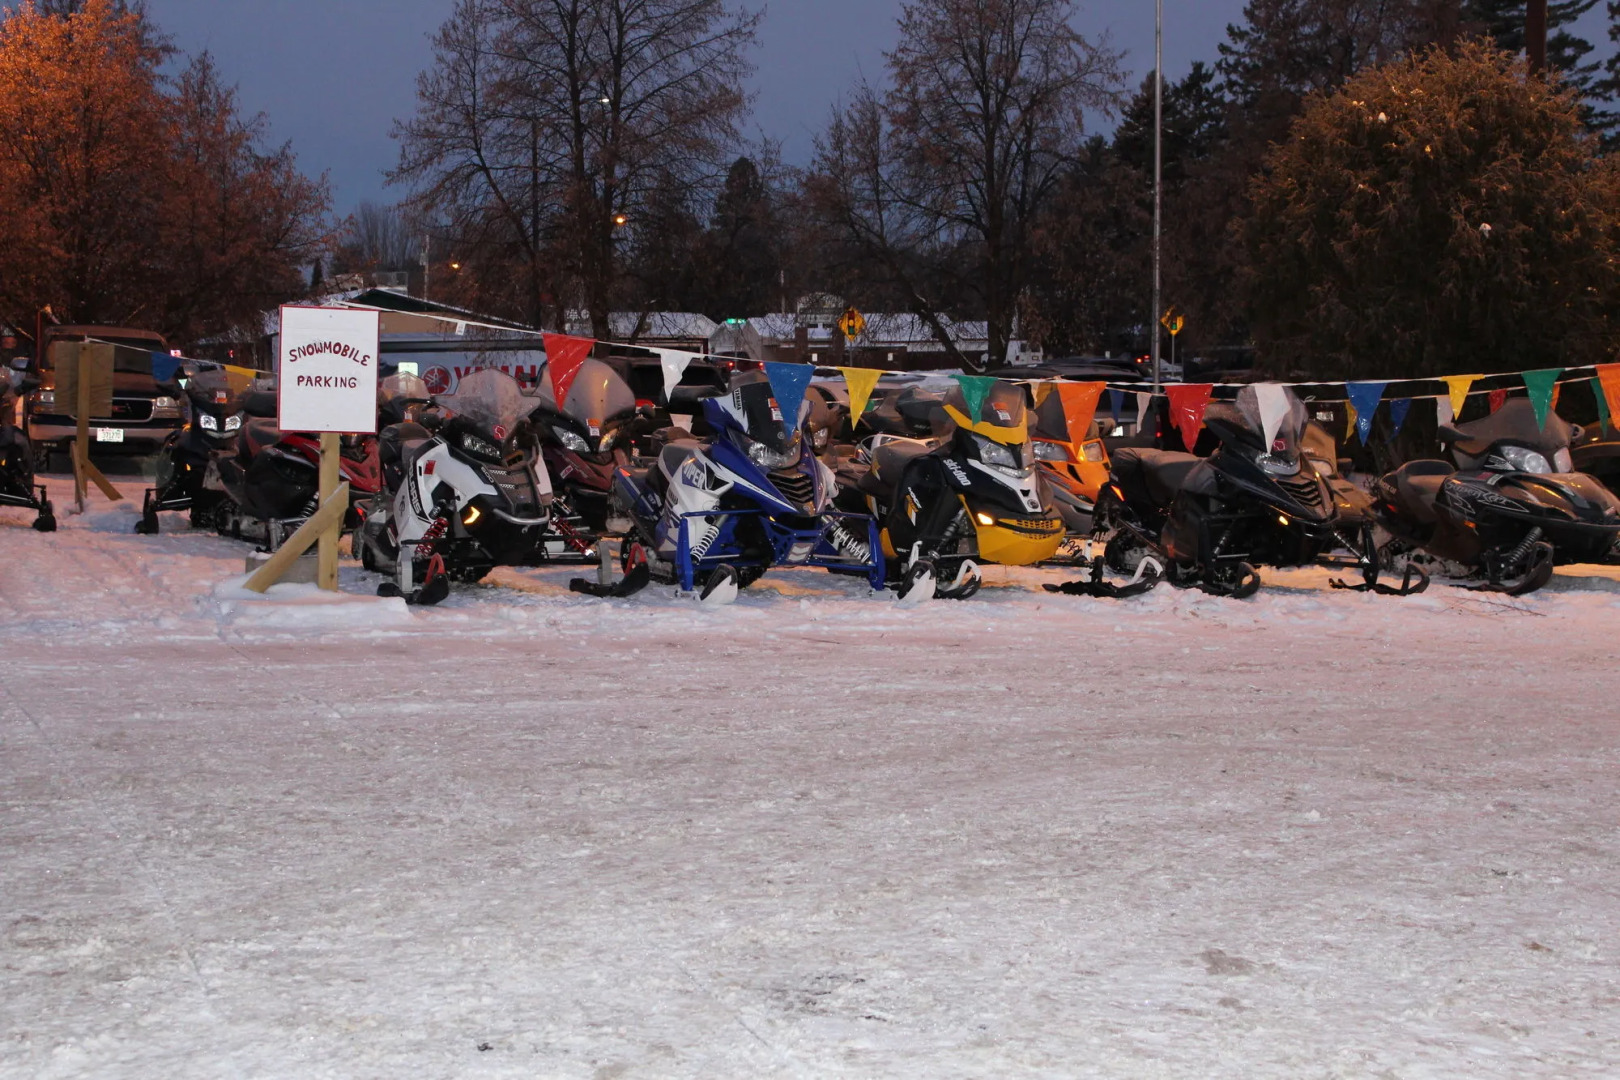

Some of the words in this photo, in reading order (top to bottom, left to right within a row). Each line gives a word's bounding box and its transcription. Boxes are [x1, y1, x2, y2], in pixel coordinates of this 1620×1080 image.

[289, 341, 371, 366] SNOWMOBILE
[297, 375, 357, 388] PARKING
[409, 456, 422, 515] POLARIS
[943, 459, 972, 486] ski-doo
